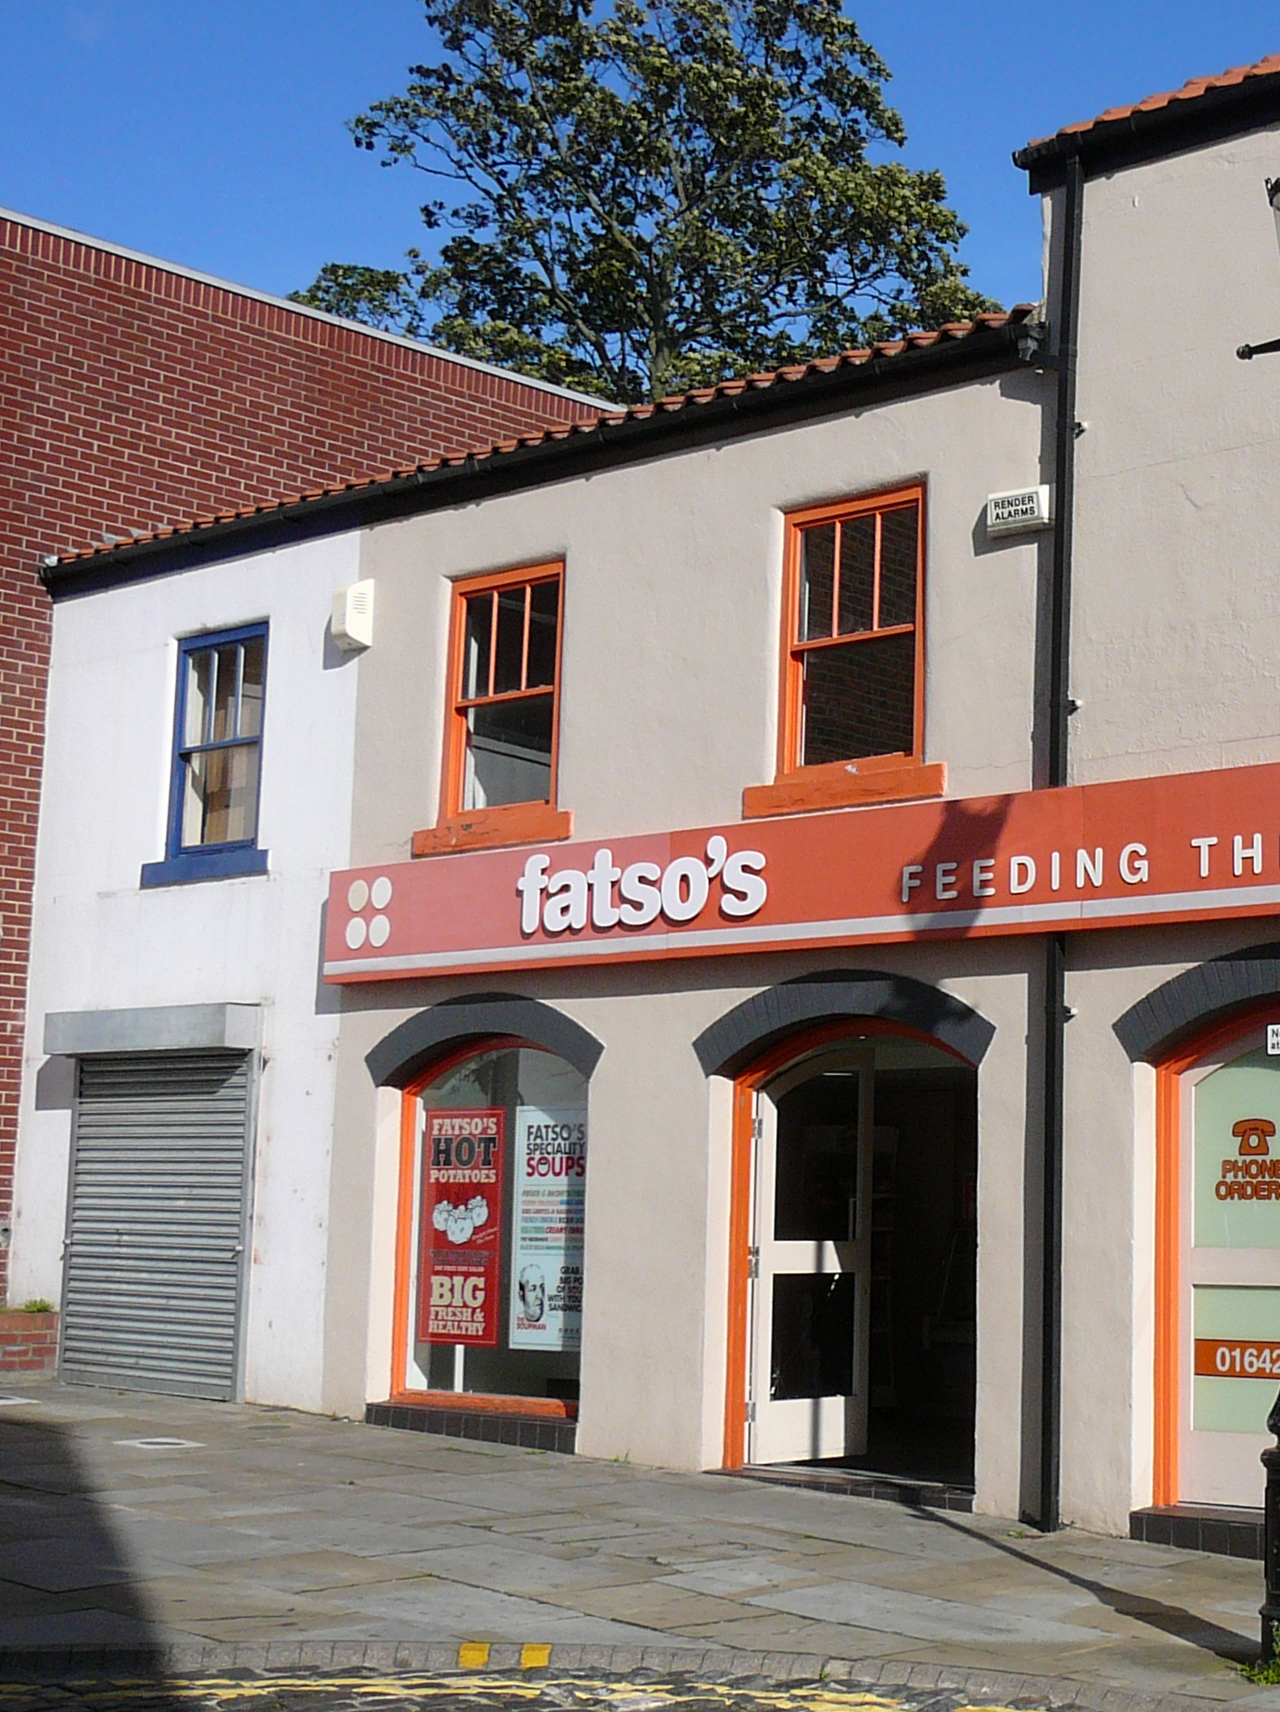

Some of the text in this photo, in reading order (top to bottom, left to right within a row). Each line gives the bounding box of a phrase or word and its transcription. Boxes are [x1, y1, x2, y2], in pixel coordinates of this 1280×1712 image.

[994, 495, 1034, 511] RENDER
[995, 506, 1035, 521] ALARMS
[902, 843, 1148, 902] FEEDING
[518, 835, 767, 934] fatso's
[1271, 1041, 1280, 1049] at
[432, 1117, 497, 1135] FATSO'S
[527, 1123, 585, 1141] FATSO'S
[430, 1135, 498, 1168] HOT
[526, 1142, 586, 1155] SPECIALITY
[526, 1156, 586, 1177] SOUPS
[429, 1169, 497, 1183] POTATOES
[430, 1275, 485, 1308] BIG
[430, 1306, 485, 1322] FRESH &
[429, 1320, 485, 1336] HEALTHY
